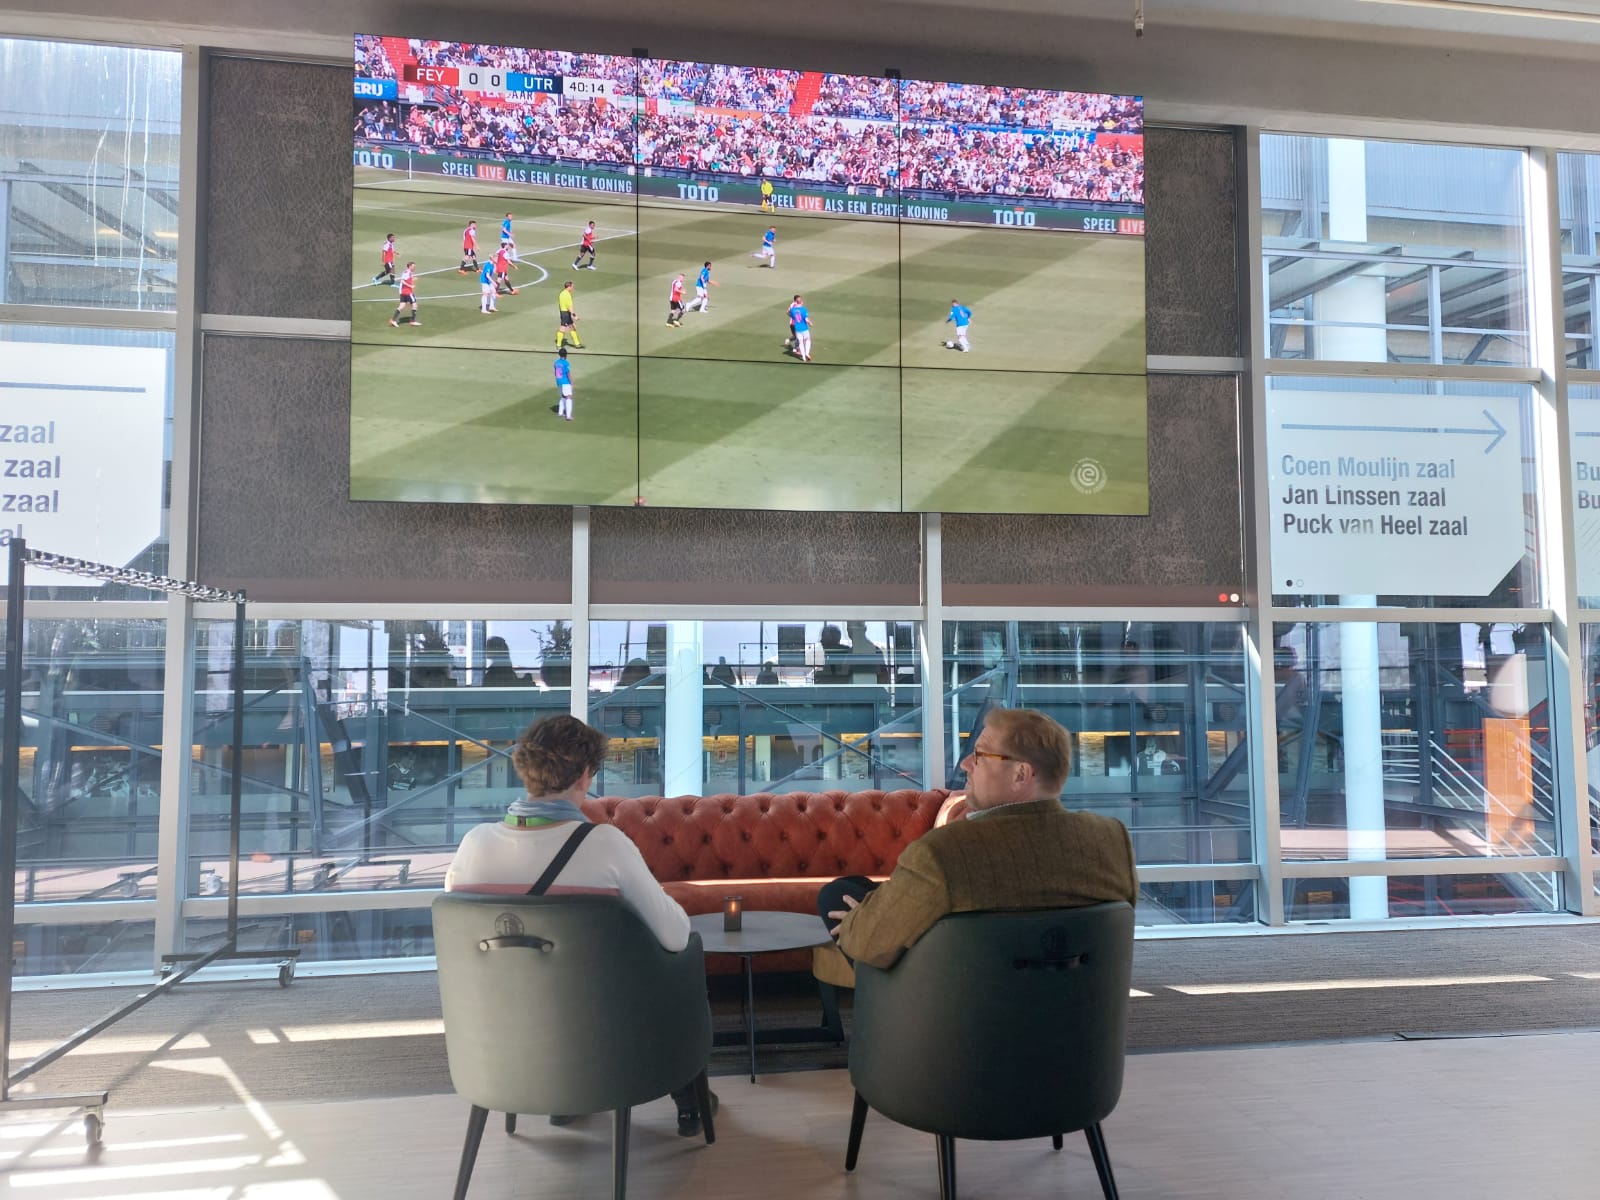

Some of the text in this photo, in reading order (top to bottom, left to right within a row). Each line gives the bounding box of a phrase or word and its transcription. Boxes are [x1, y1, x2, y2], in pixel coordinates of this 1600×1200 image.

[416, 68, 605, 94] FEY 0 0 UTR 40:14
[442, 161, 632, 193] SPEEL LIVE ALS EEN ECHTE KONING
[678, 183, 719, 202] TOTO
[768, 193, 948, 220] PEEL LIVE ALS EEN ECHTE KONING
[993, 209, 1036, 226] TOTO
[1083, 217, 1144, 233] SPEEL LIVE
[0, 421, 55, 444] zaal
[4, 456, 61, 479] zaal
[1281, 455, 1456, 481] Coen Moulijn zaal
[2, 490, 59, 513] zaal
[1282, 484, 1446, 507] Jan Linssen zaal
[1283, 513, 1468, 536] Puck van Heel zaal
